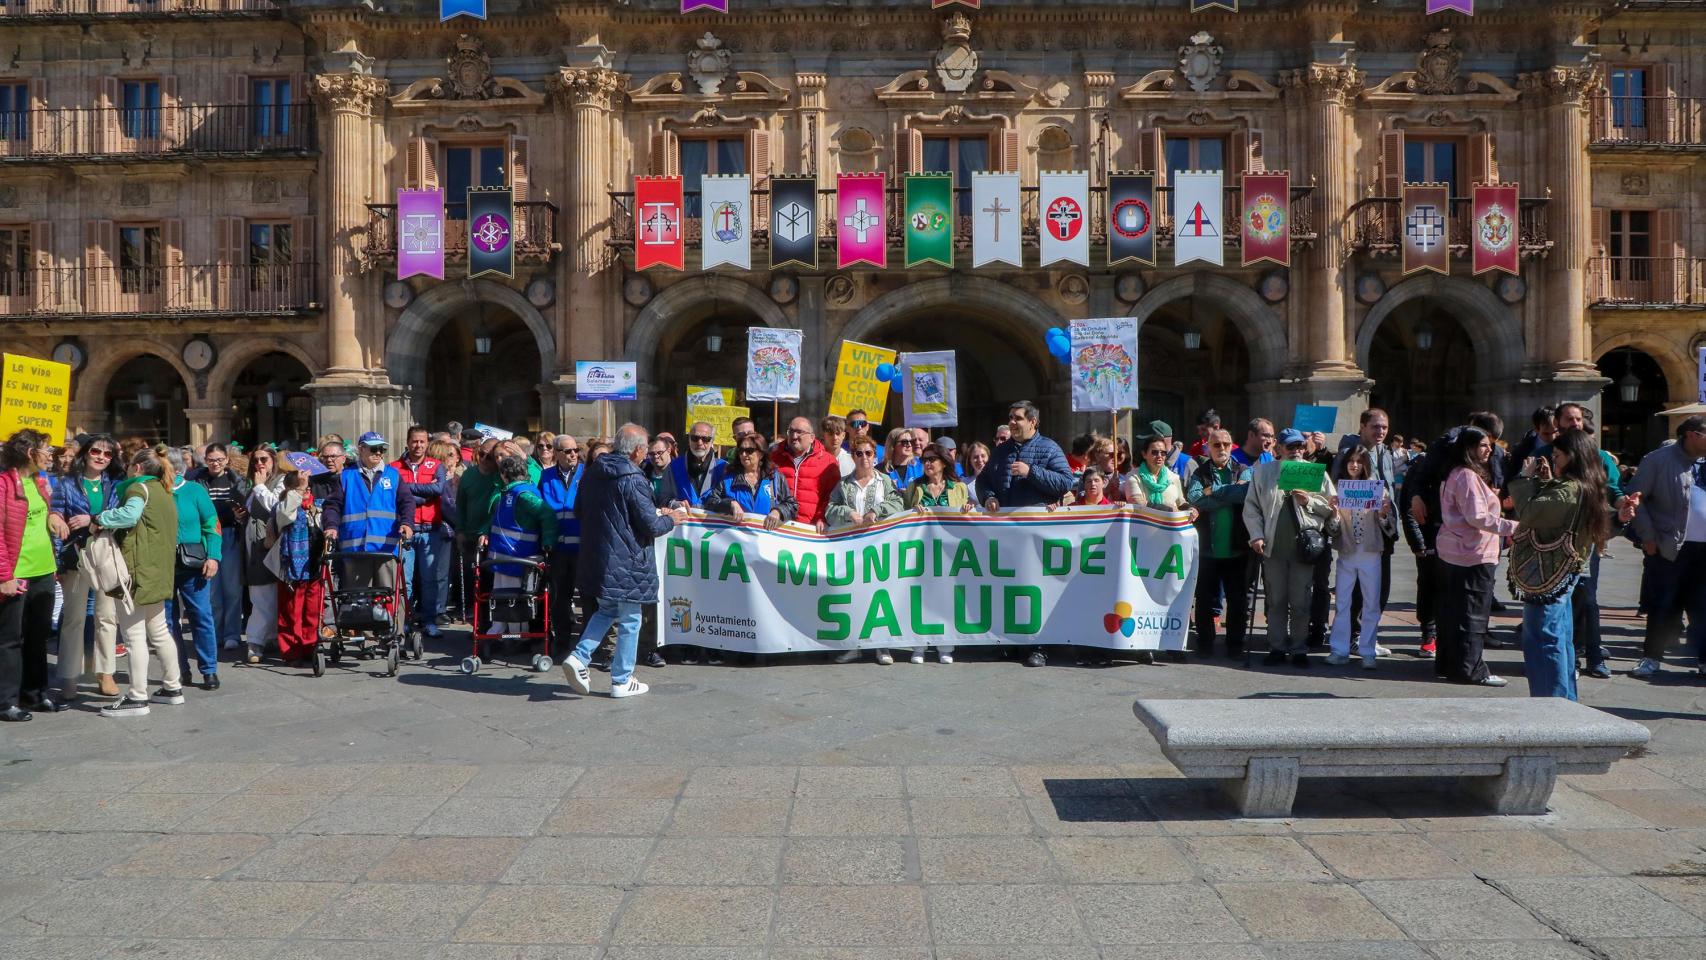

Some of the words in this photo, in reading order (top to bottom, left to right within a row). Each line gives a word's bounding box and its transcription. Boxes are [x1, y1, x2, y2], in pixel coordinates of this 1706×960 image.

[12, 363, 24, 373] LA
[6, 380, 18, 389] ES
[21, 382, 40, 392] MUY
[44, 386, 63, 396] DURA
[848, 381, 878, 396] CON
[5, 398, 24, 407] PERO
[27, 400, 48, 410] TODO
[51, 404, 62, 412] SE
[17, 416, 53, 428] SUPERA
[667, 529, 751, 583] DÍA
[777, 538, 1016, 587] MUNDIAL
[1042, 536, 1106, 576] DE
[1130, 536, 1185, 580] LA
[695, 611, 757, 627] Ayuntamiento
[816, 585, 1042, 641] SALUD
[1137, 616, 1182, 630] SALUD
[695, 625, 705, 633] de
[708, 625, 757, 640] Salamanca
